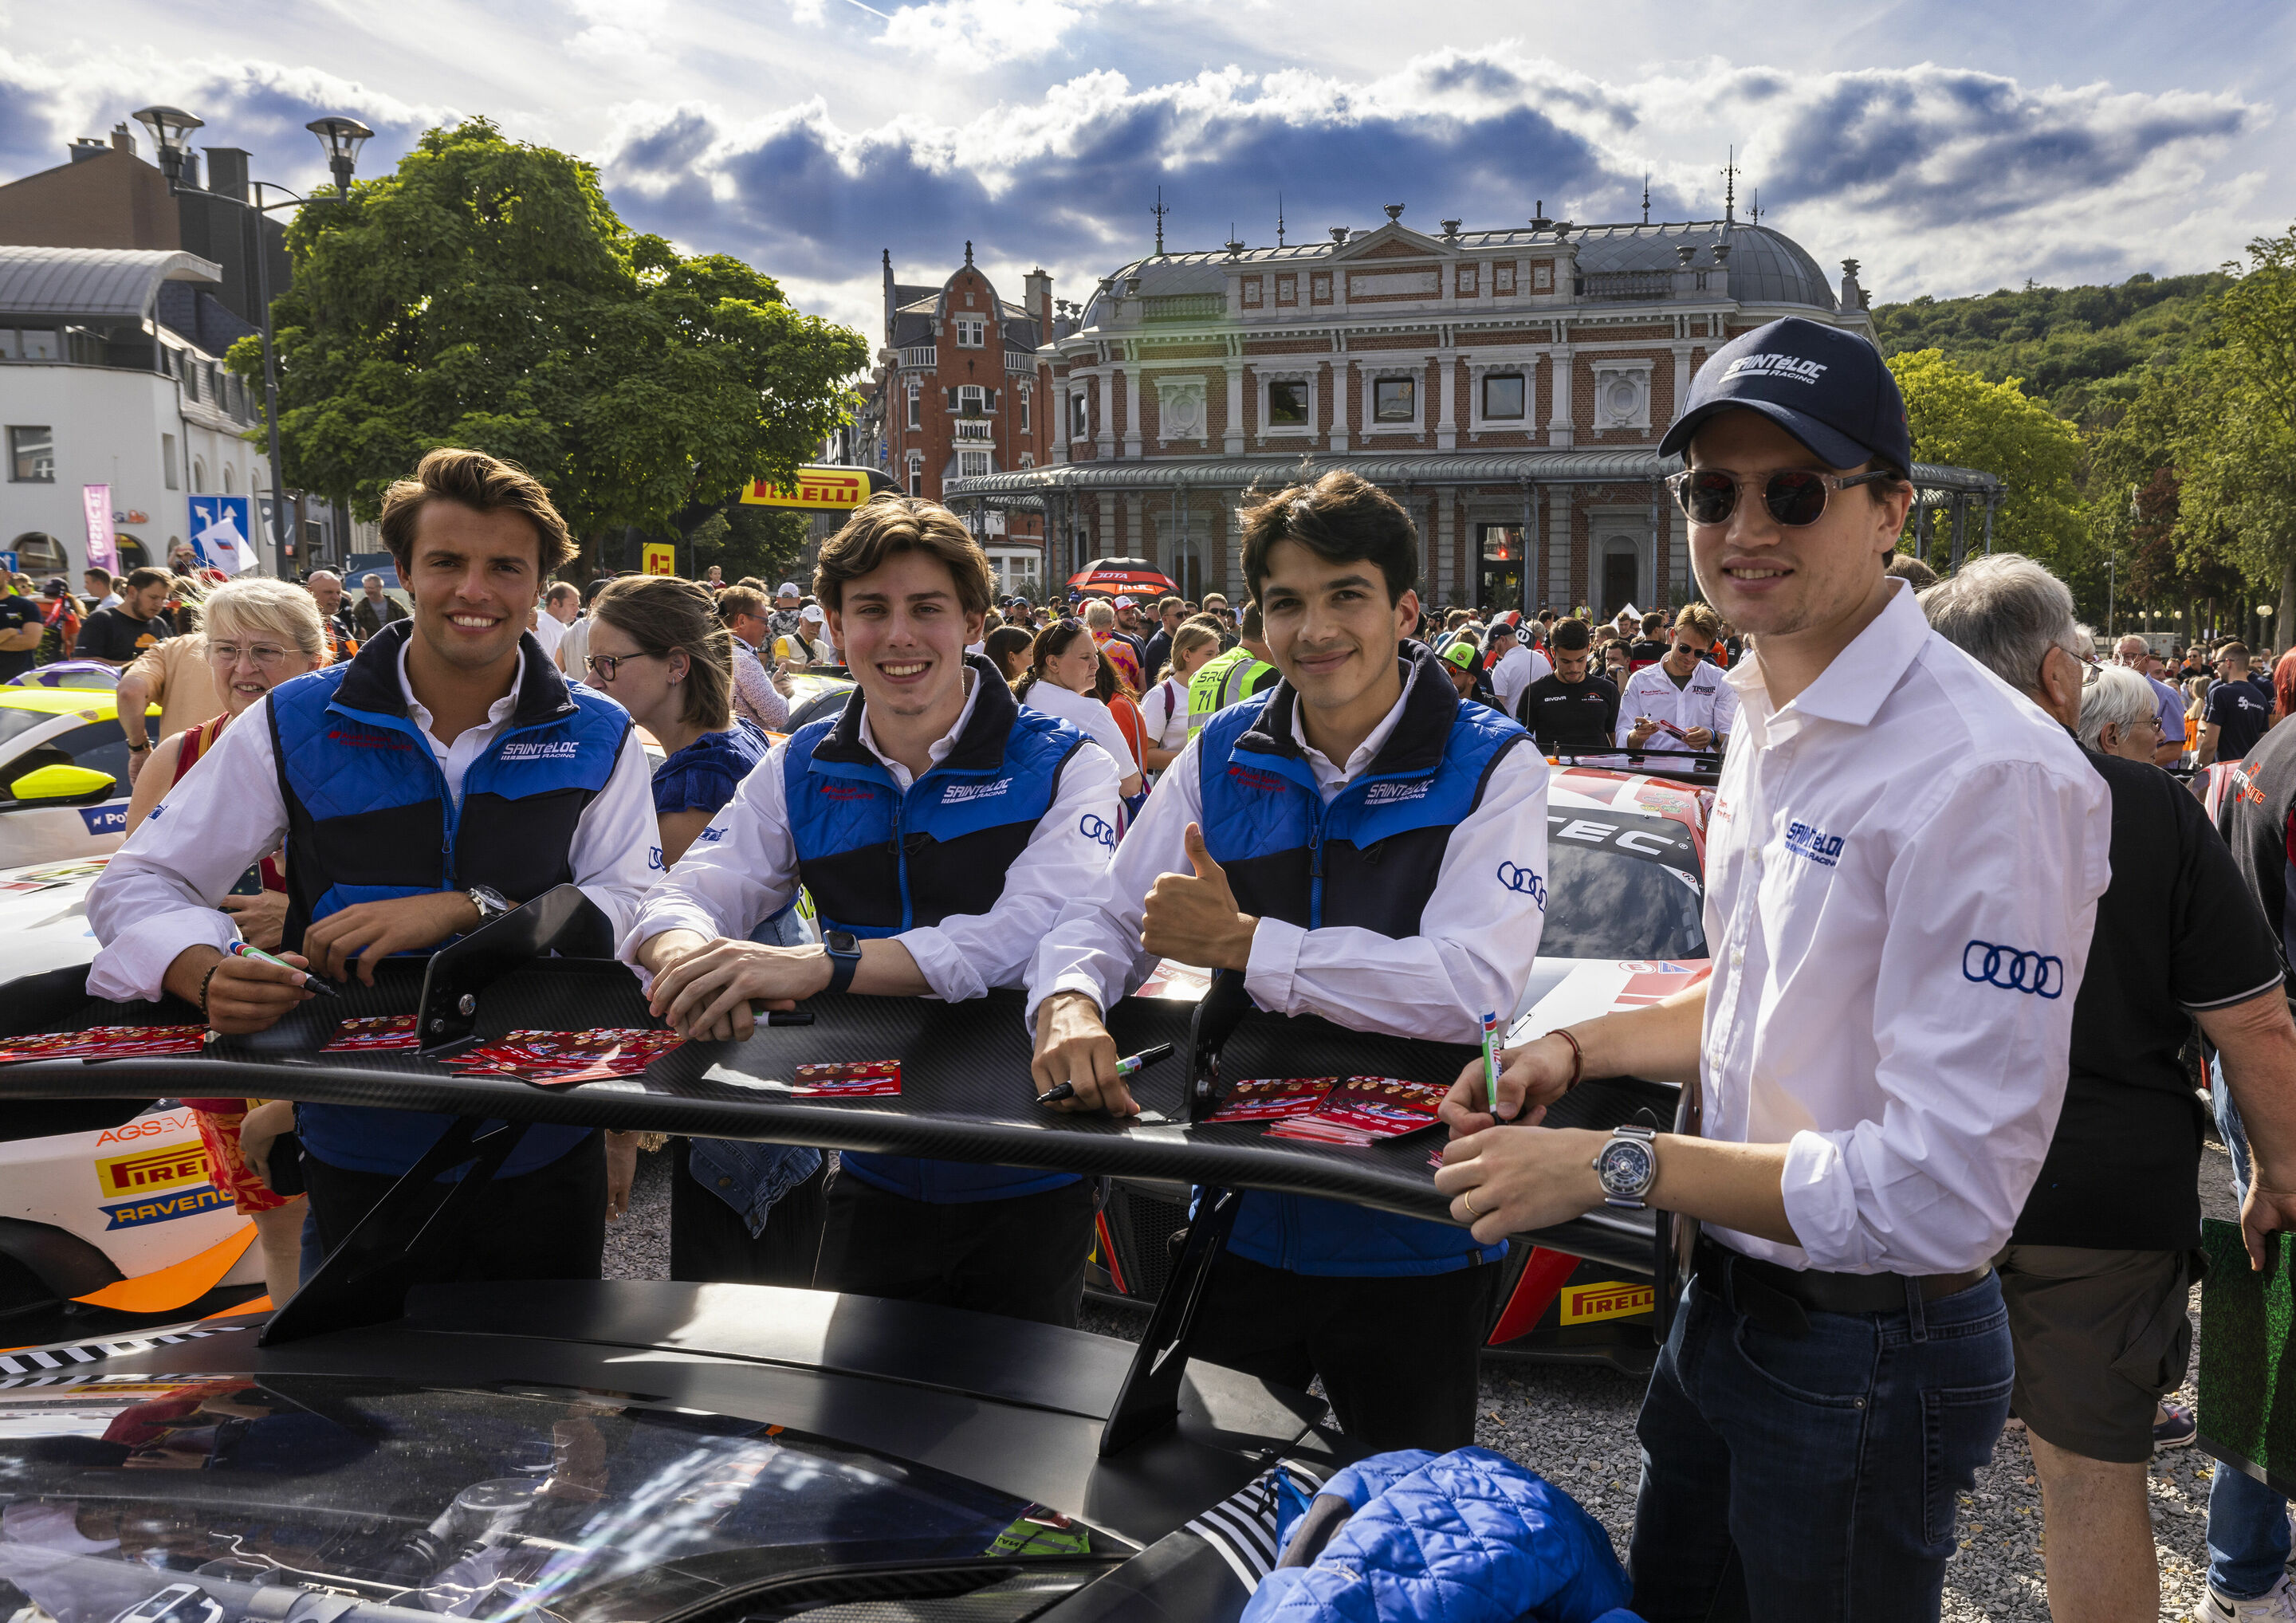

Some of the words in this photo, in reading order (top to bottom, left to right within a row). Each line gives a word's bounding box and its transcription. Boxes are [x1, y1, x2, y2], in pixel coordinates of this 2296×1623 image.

[1724, 353, 1828, 379] SAINTéLOC
[1769, 370, 1816, 384] RACING
[1197, 690, 1213, 711] 71
[502, 741, 580, 755] SAINTéLOC
[1809, 852, 1837, 867] RACIN
[1572, 1284, 1654, 1316] PIRELL
